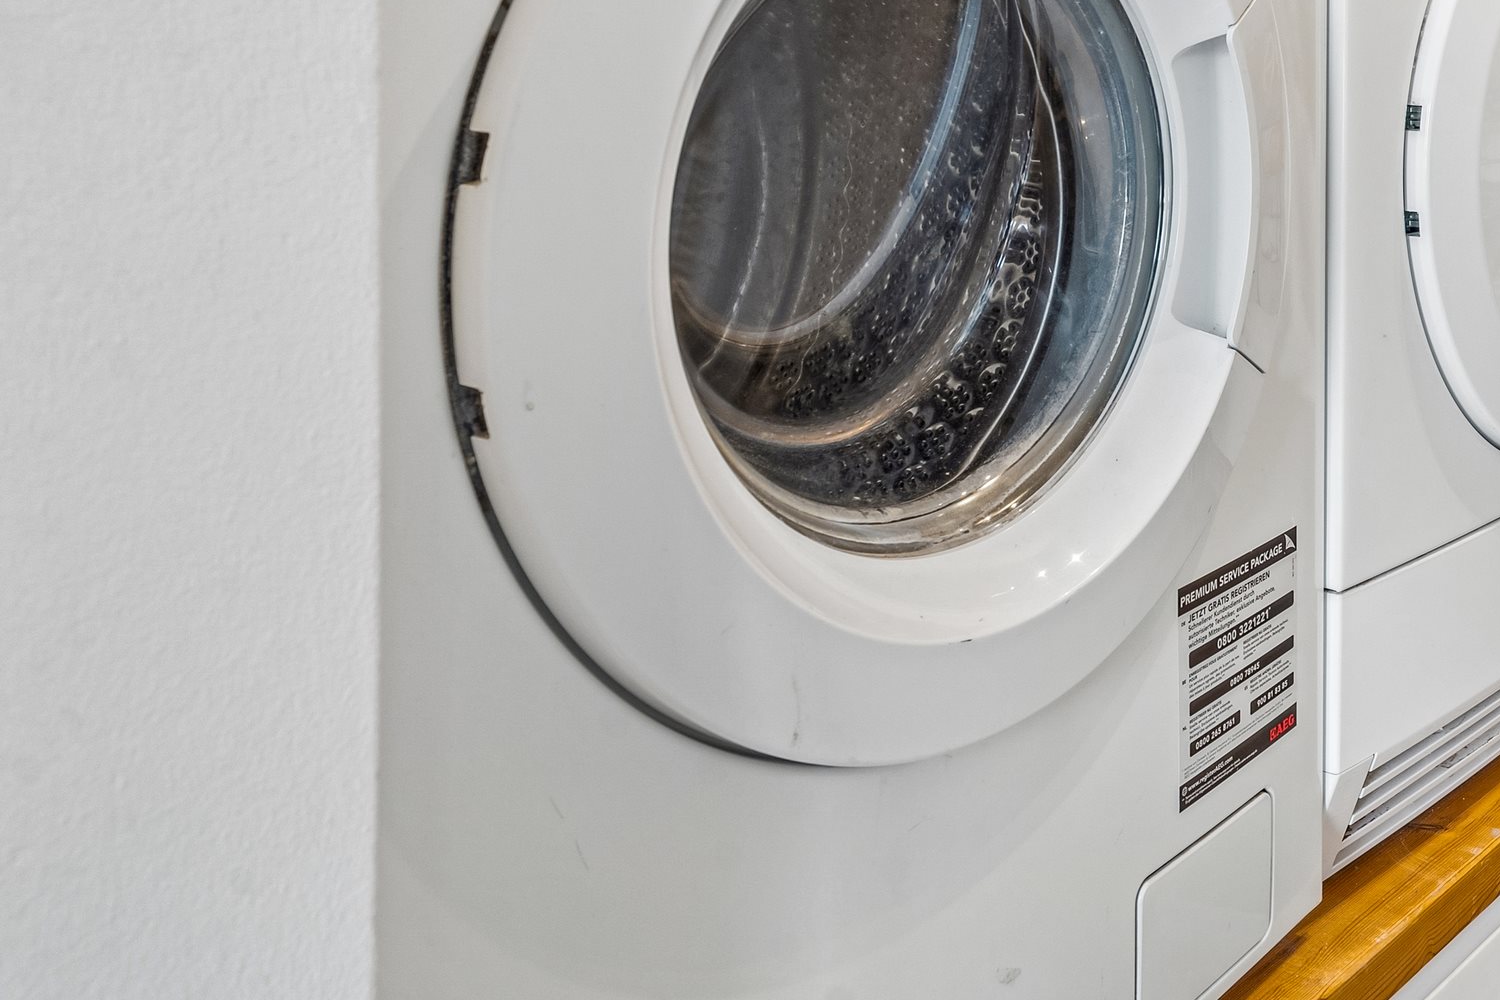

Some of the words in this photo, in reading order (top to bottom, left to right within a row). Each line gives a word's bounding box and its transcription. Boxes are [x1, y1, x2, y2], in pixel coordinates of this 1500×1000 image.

[1180, 579, 1218, 608] PREMIUM
[1219, 563, 1249, 587] SERVICE
[1250, 543, 1283, 570] PACKAGE
[1188, 607, 1206, 624] JETZT
[1208, 593, 1229, 612] GRATIS
[1230, 570, 1270, 600] REGISTRIEREN
[1214, 596, 1242, 619] Kundendienst
[1217, 630, 1237, 649] 0800
[1229, 673, 1244, 688] 0800
[1244, 661, 1260, 678] 78945
[1256, 696, 1267, 708] 900
[1195, 735, 1209, 750] 0800
